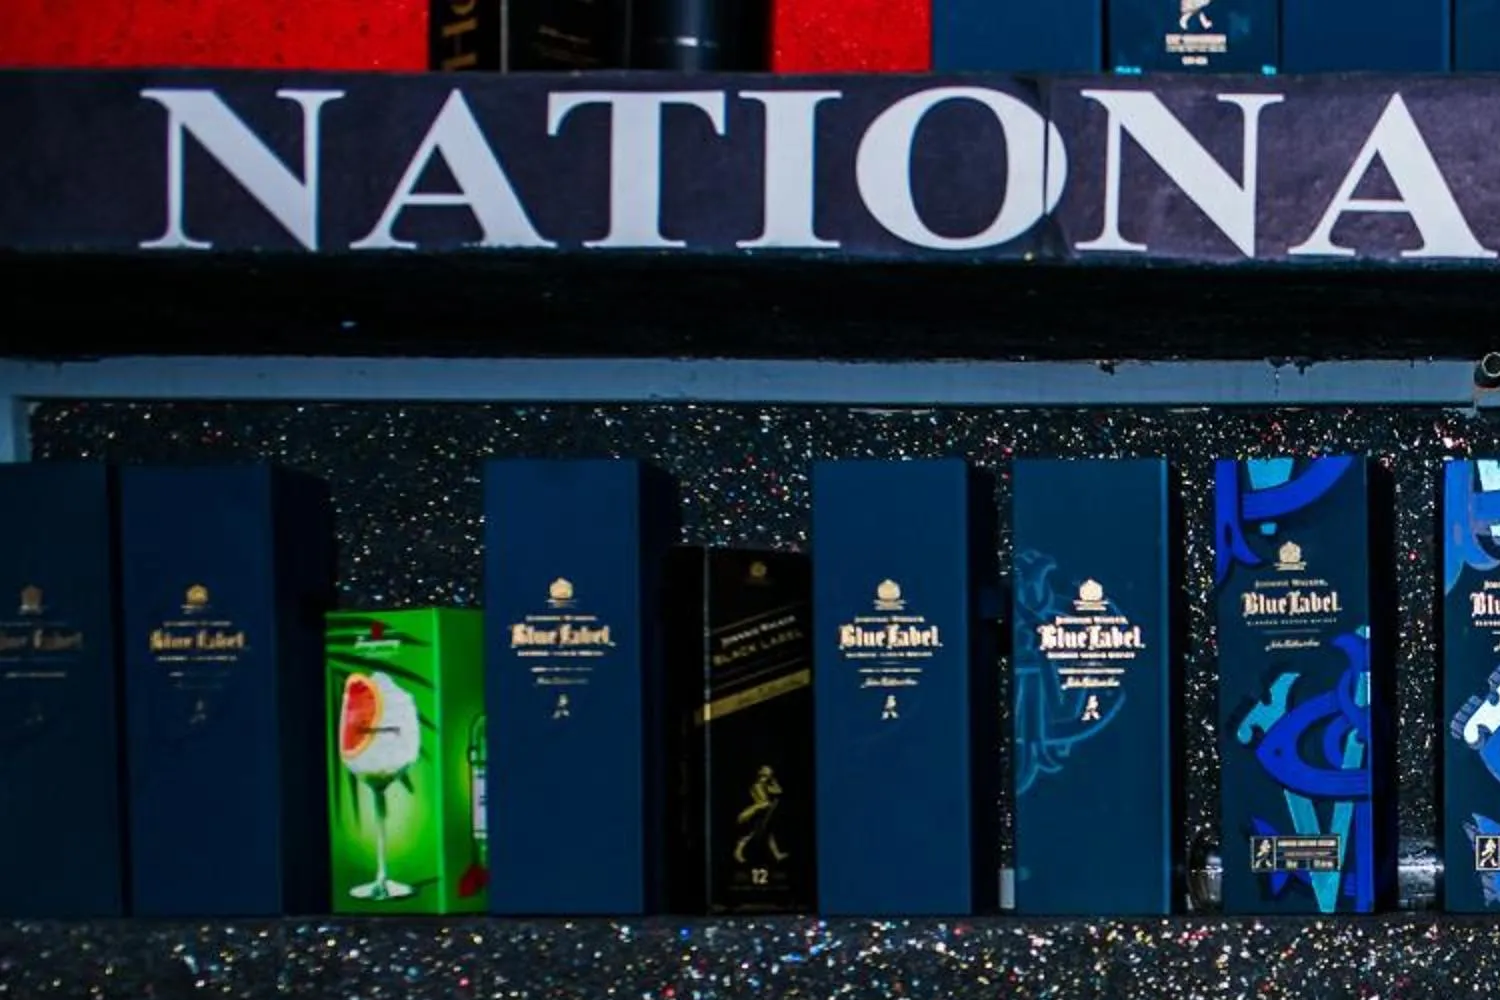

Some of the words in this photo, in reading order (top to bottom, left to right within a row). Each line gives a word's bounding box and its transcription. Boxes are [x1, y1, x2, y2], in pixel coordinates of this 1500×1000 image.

[1241, 592, 1287, 617] Blue
[1286, 591, 1340, 616] Label
[839, 625, 886, 650] Blue
[887, 624, 941, 650] Label
[1036, 625, 1086, 650] Blue
[1086, 624, 1143, 650] Label
[751, 868, 769, 884] 12
